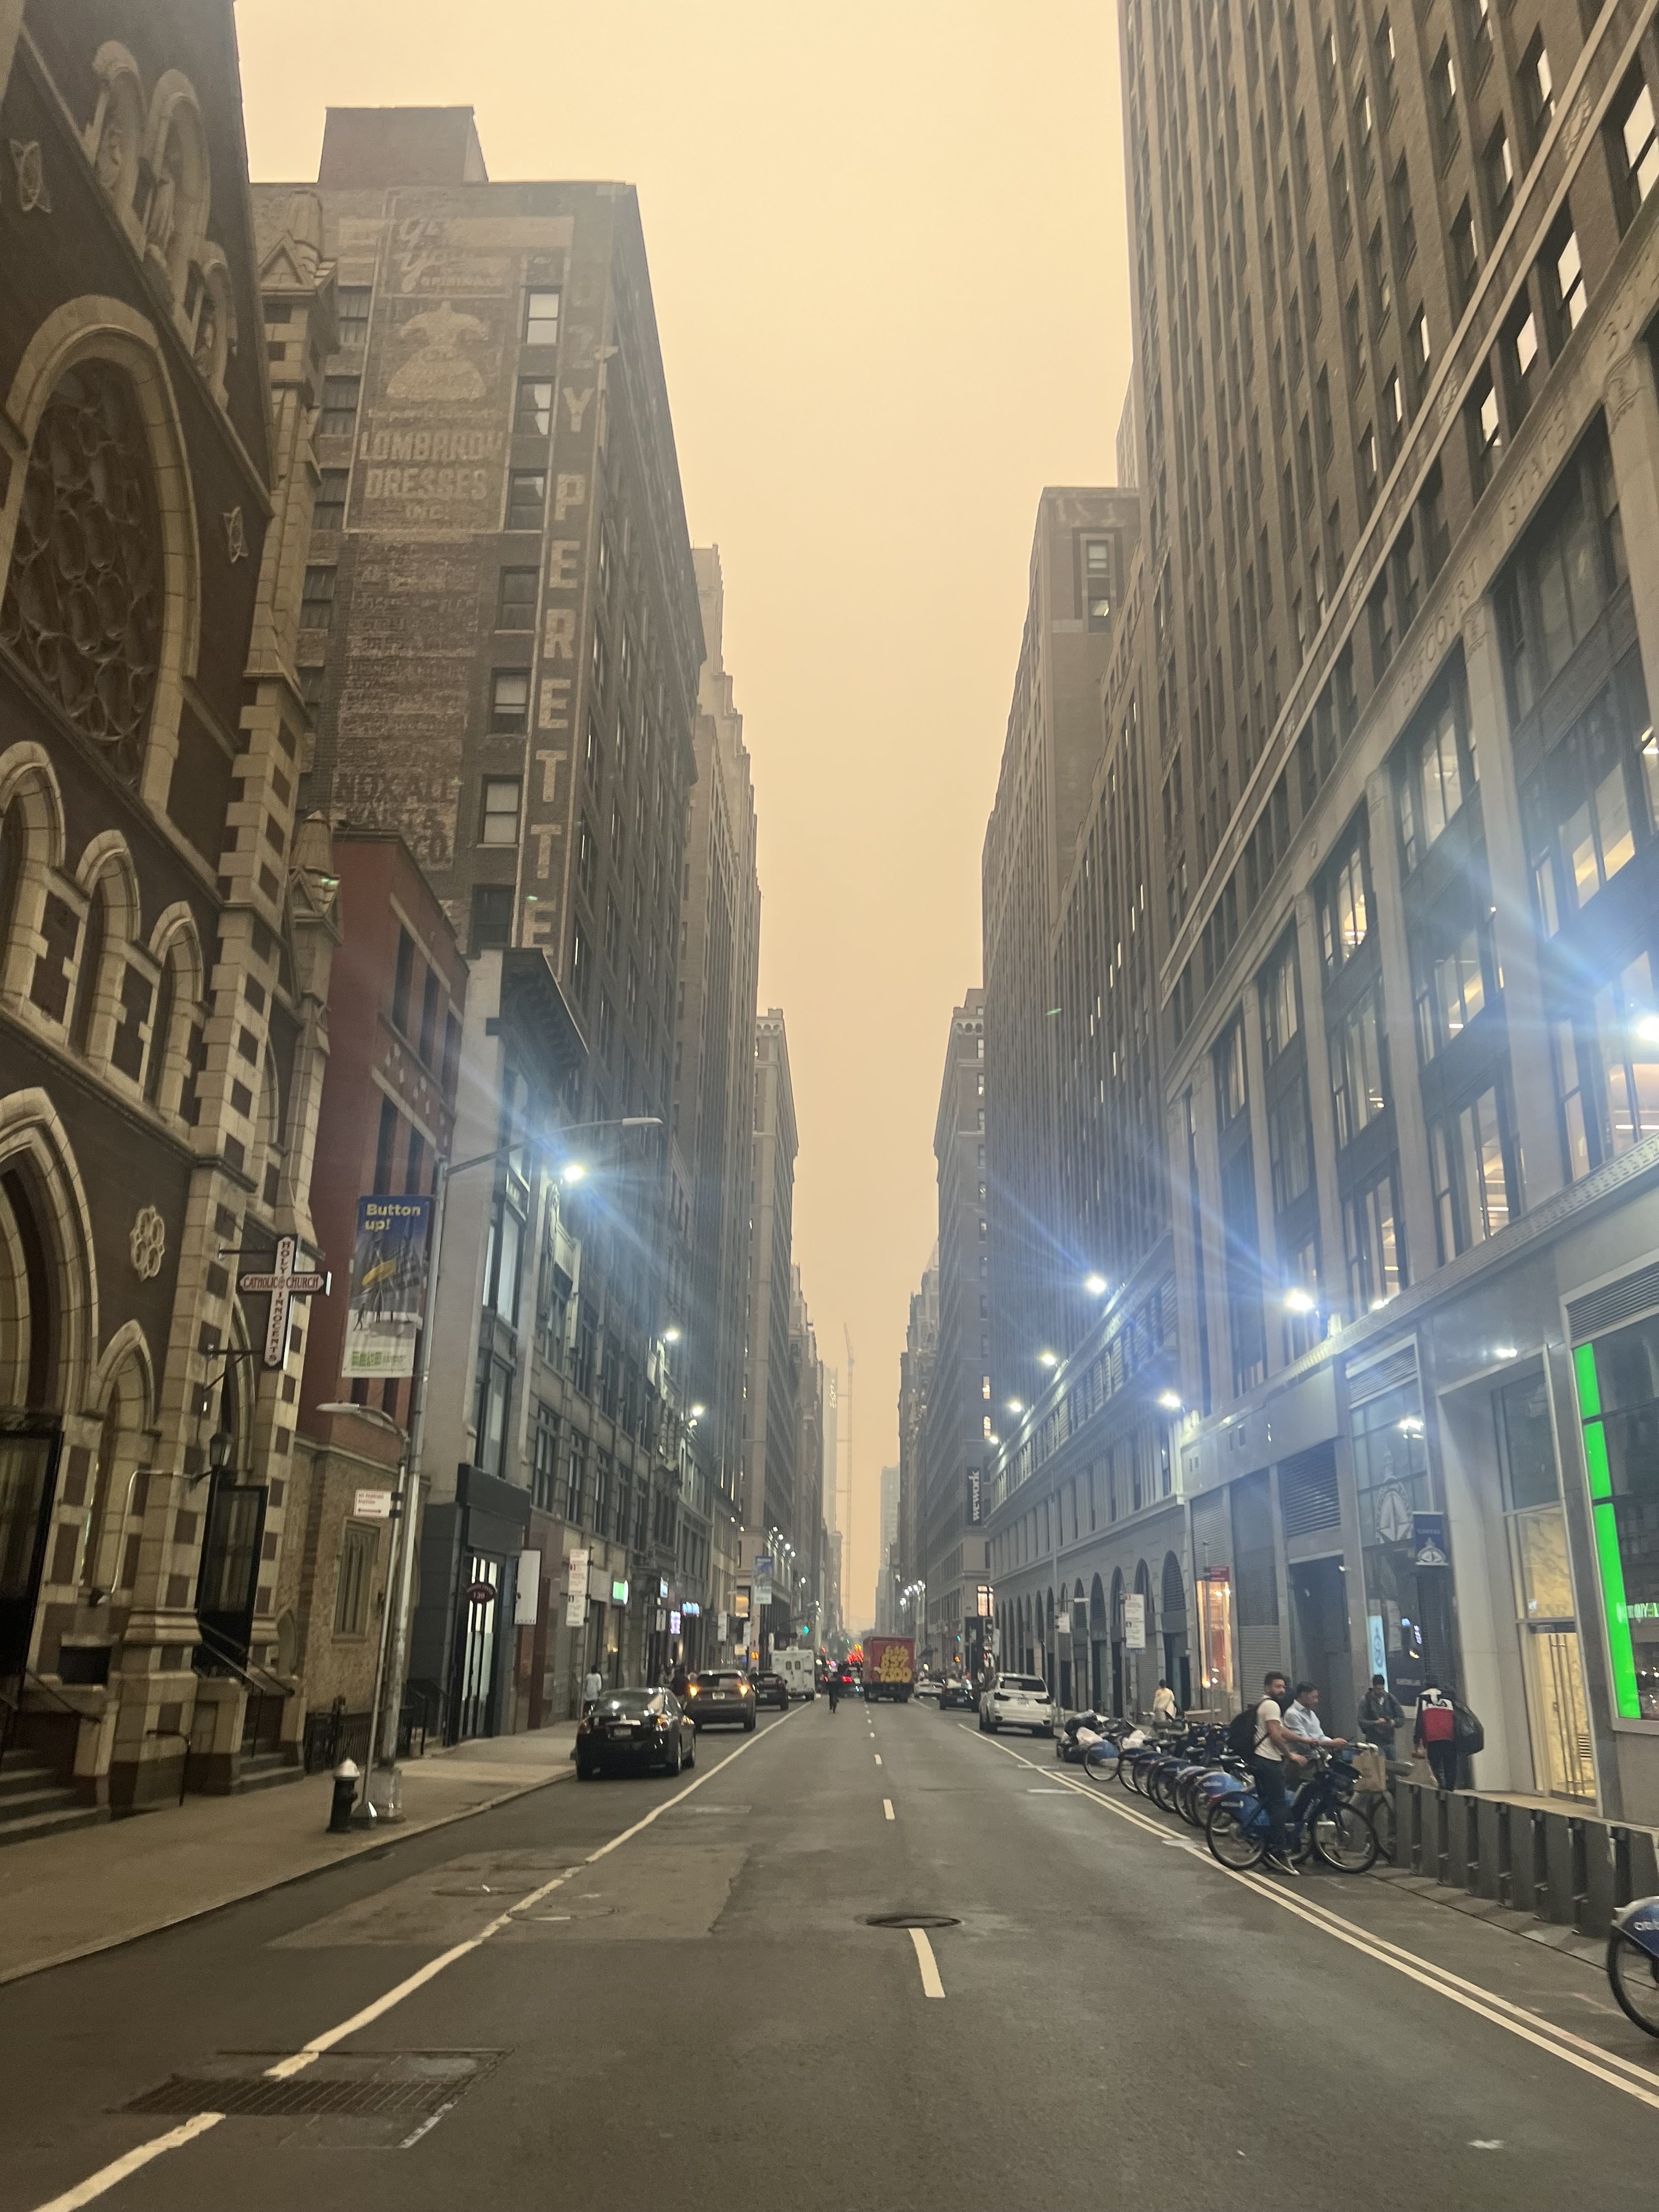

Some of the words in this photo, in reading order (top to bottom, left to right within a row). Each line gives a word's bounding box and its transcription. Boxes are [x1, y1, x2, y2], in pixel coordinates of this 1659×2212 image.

[366, 1203, 421, 1217] Button
[364, 1218, 391, 1232] up!
[280, 1241, 291, 1274] HOLY
[244, 1276, 279, 1289] CATHOLIC
[285, 1276, 320, 1289] CHURCH
[269, 1291, 284, 1361] INNOCENTS
[968, 1469, 980, 1523] wework
